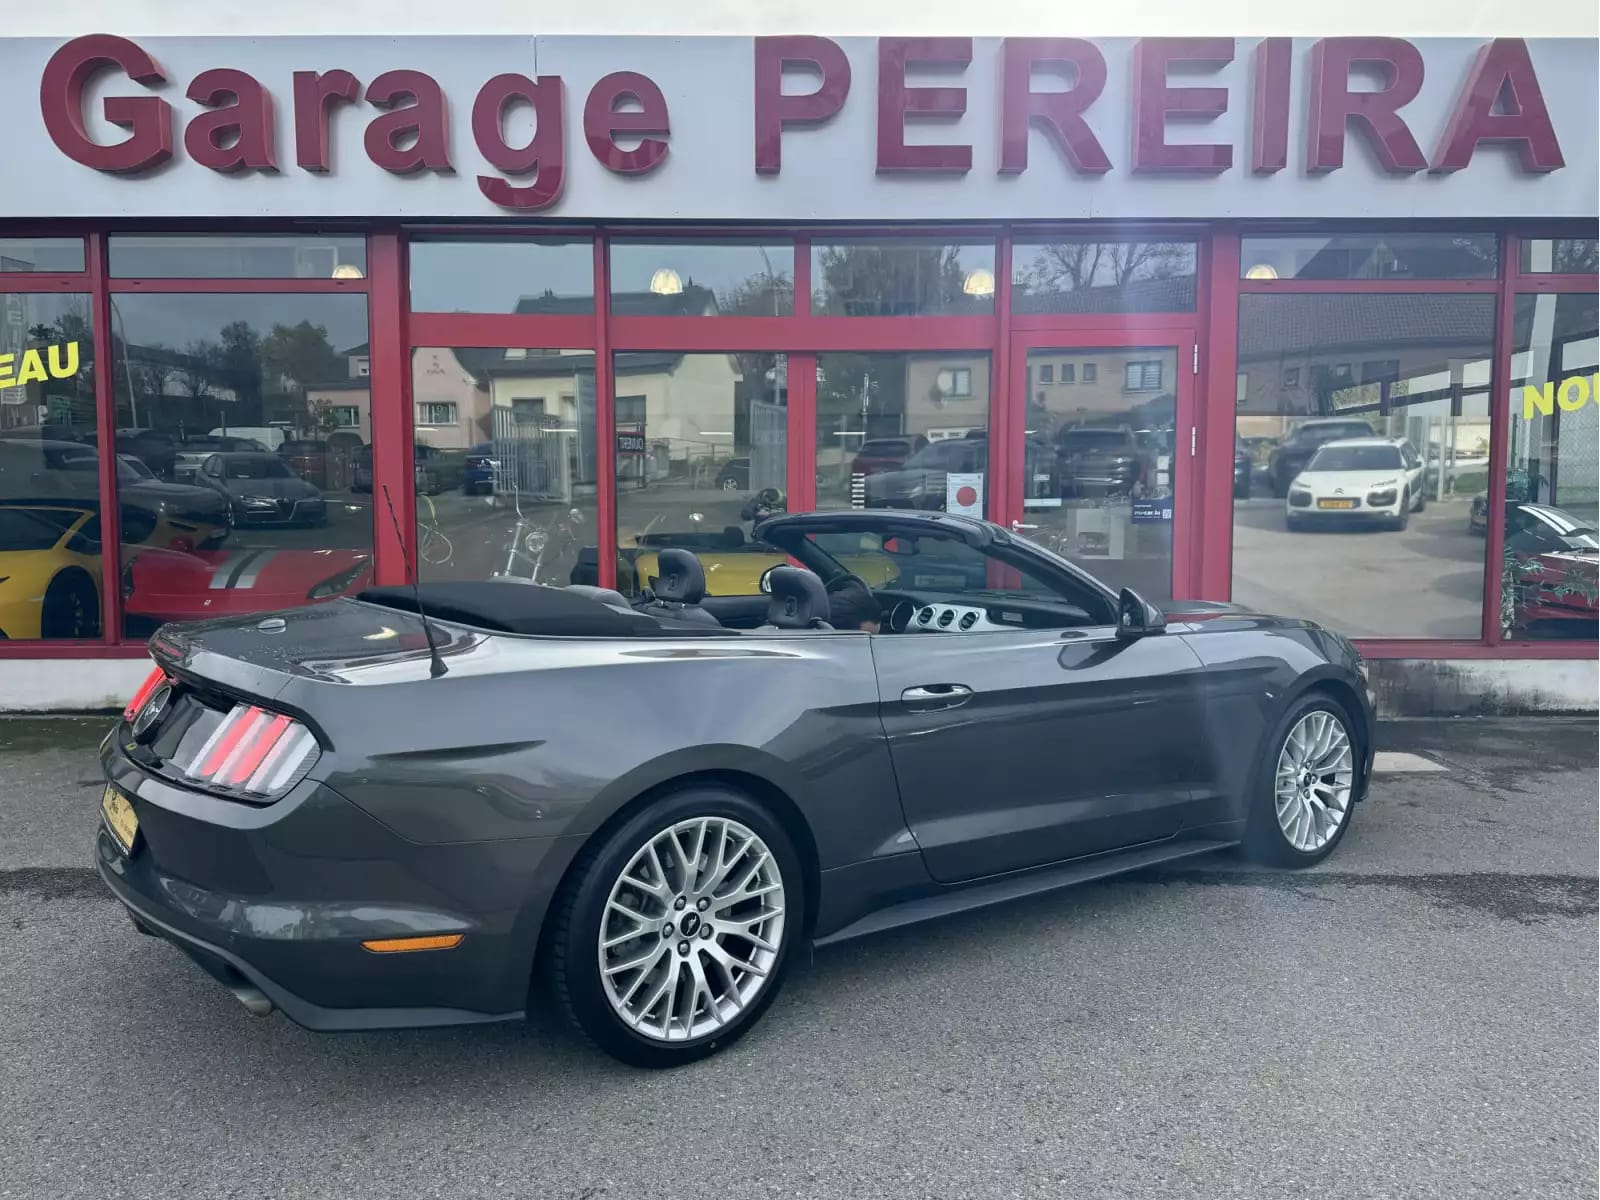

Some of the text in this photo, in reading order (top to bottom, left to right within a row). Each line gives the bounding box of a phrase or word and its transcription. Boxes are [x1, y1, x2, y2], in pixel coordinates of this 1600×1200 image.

[40, 33, 1566, 211] Garage PEREIRA
[1523, 372, 1599, 420] NO
